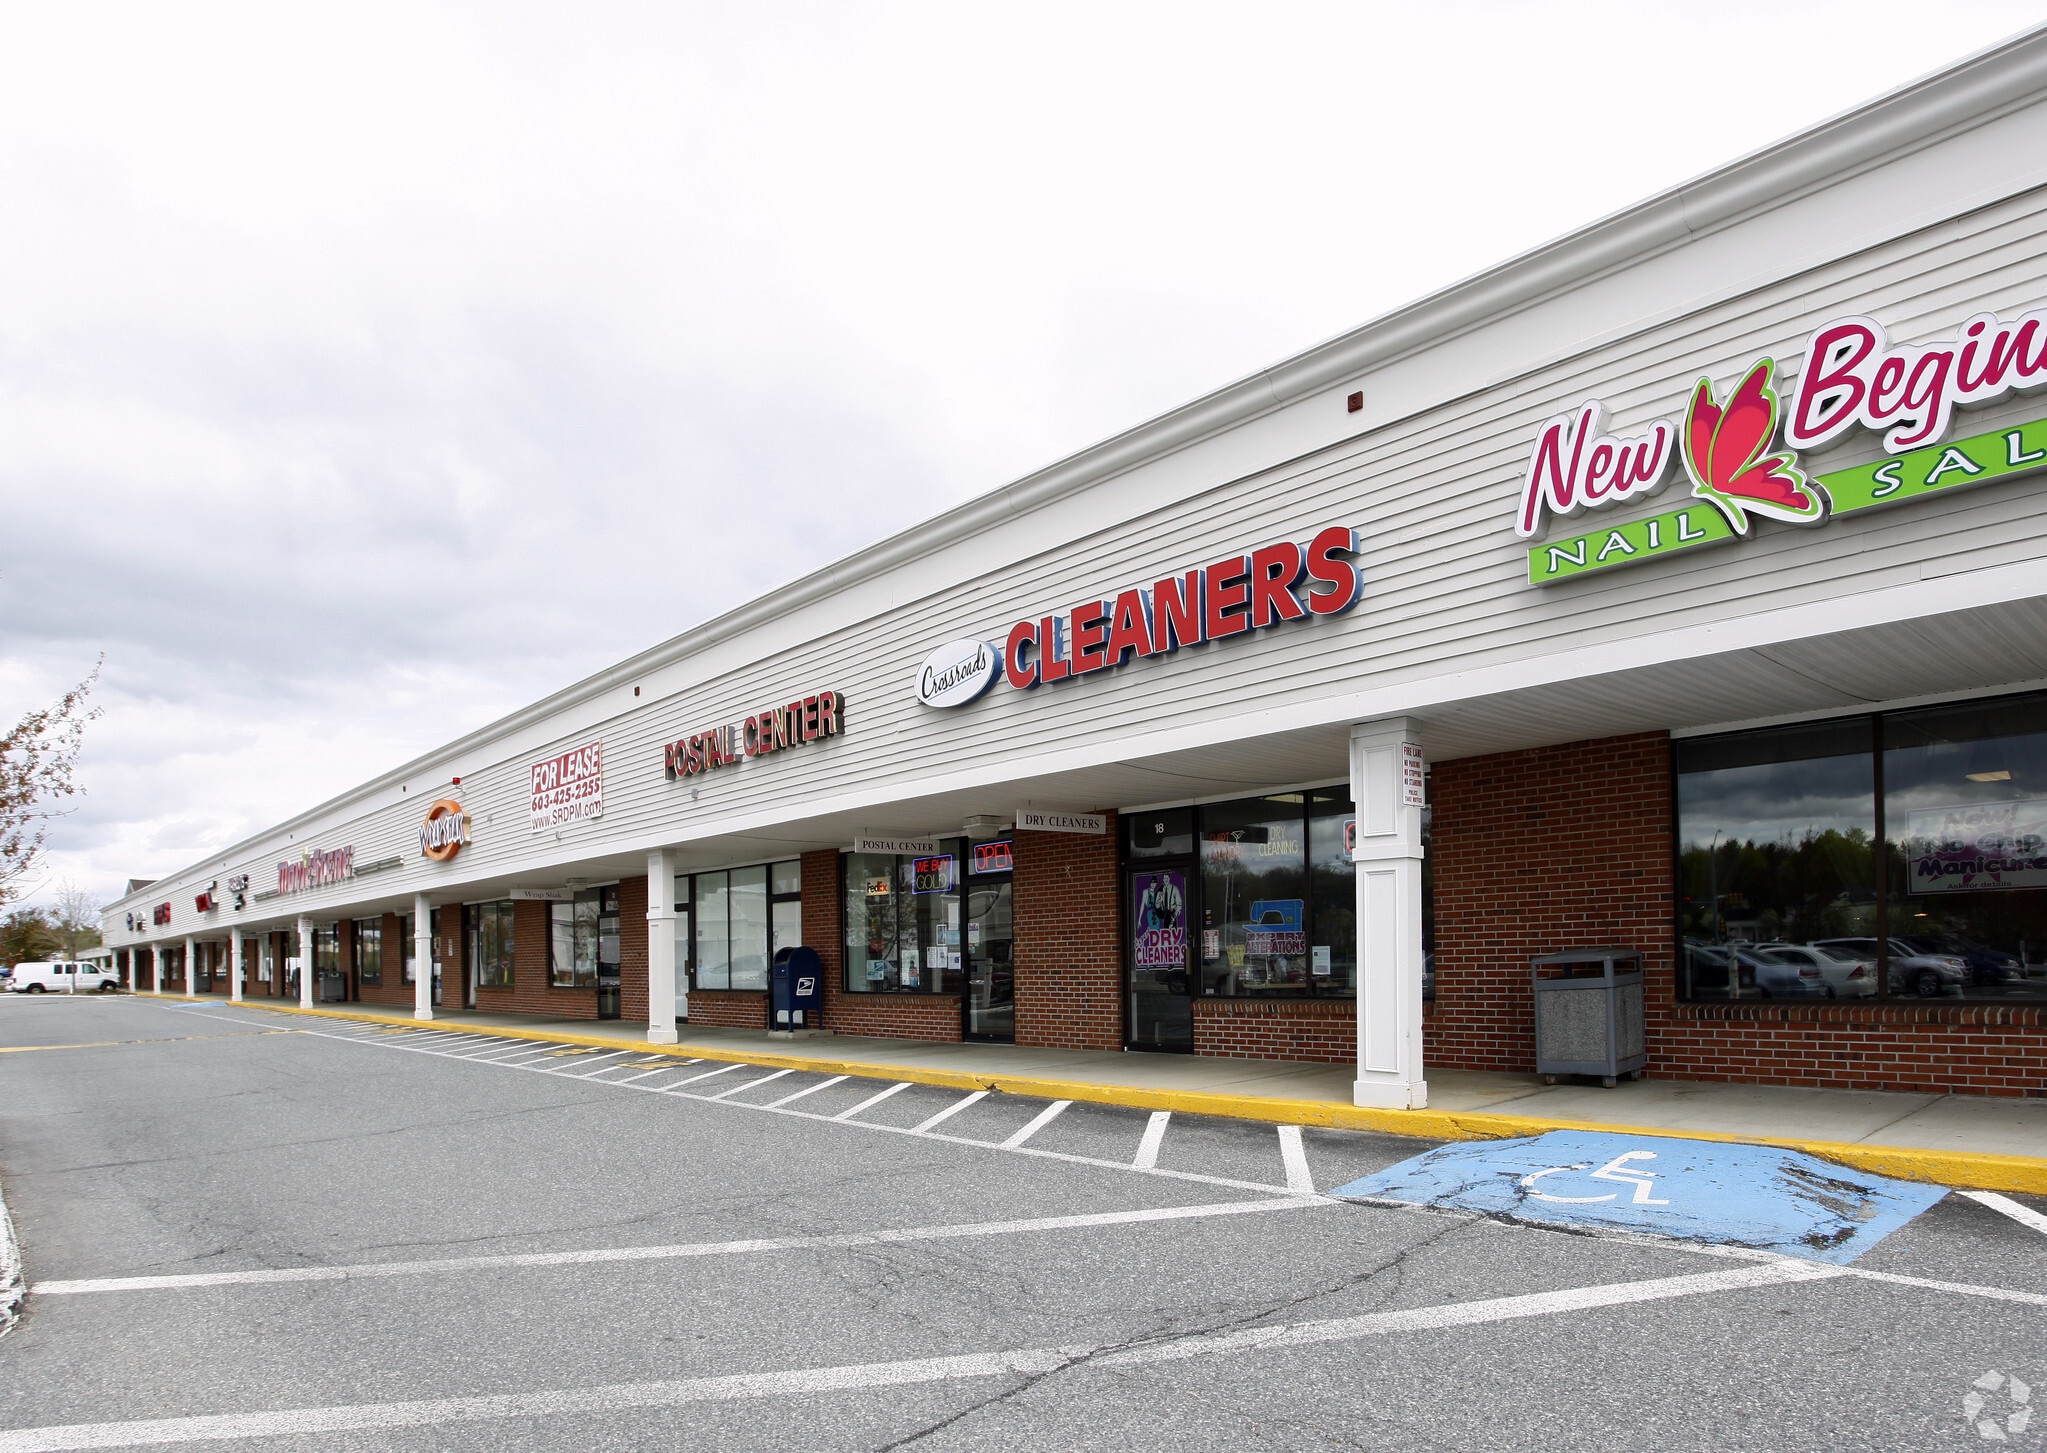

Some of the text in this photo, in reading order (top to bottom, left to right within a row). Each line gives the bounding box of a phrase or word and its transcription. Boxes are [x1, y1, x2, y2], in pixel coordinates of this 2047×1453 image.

[1523, 319, 2047, 532] New Begin
[1545, 429, 2047, 574] NAIL SAL
[921, 525, 1360, 699] Crossroads CLEANERS
[664, 690, 842, 780] POSTAL CENTER
[532, 744, 599, 793] FOR LEASE
[531, 776, 600, 812] 603-425-2255
[531, 800, 601, 830] www.SRDPM.com
[1025, 814, 1100, 829] DRY CLEANERS
[1154, 822, 1165, 834] 18
[1270, 825, 1286, 840] DRY
[862, 840, 934, 852] POSTAL CENTER
[1258, 839, 1298, 857] CLEANING
[916, 858, 949, 873] WE BUY
[975, 843, 1014, 870] OPEN
[867, 881, 888, 894] FedEx
[916, 873, 948, 890] GOLD
[524, 890, 544, 899] Wrap
[1149, 928, 1183, 947] DRY
[1246, 931, 1305, 941] EXPERT
[1135, 944, 1187, 966] CLEANERS
[1245, 940, 1306, 955] ALTERATIONS
